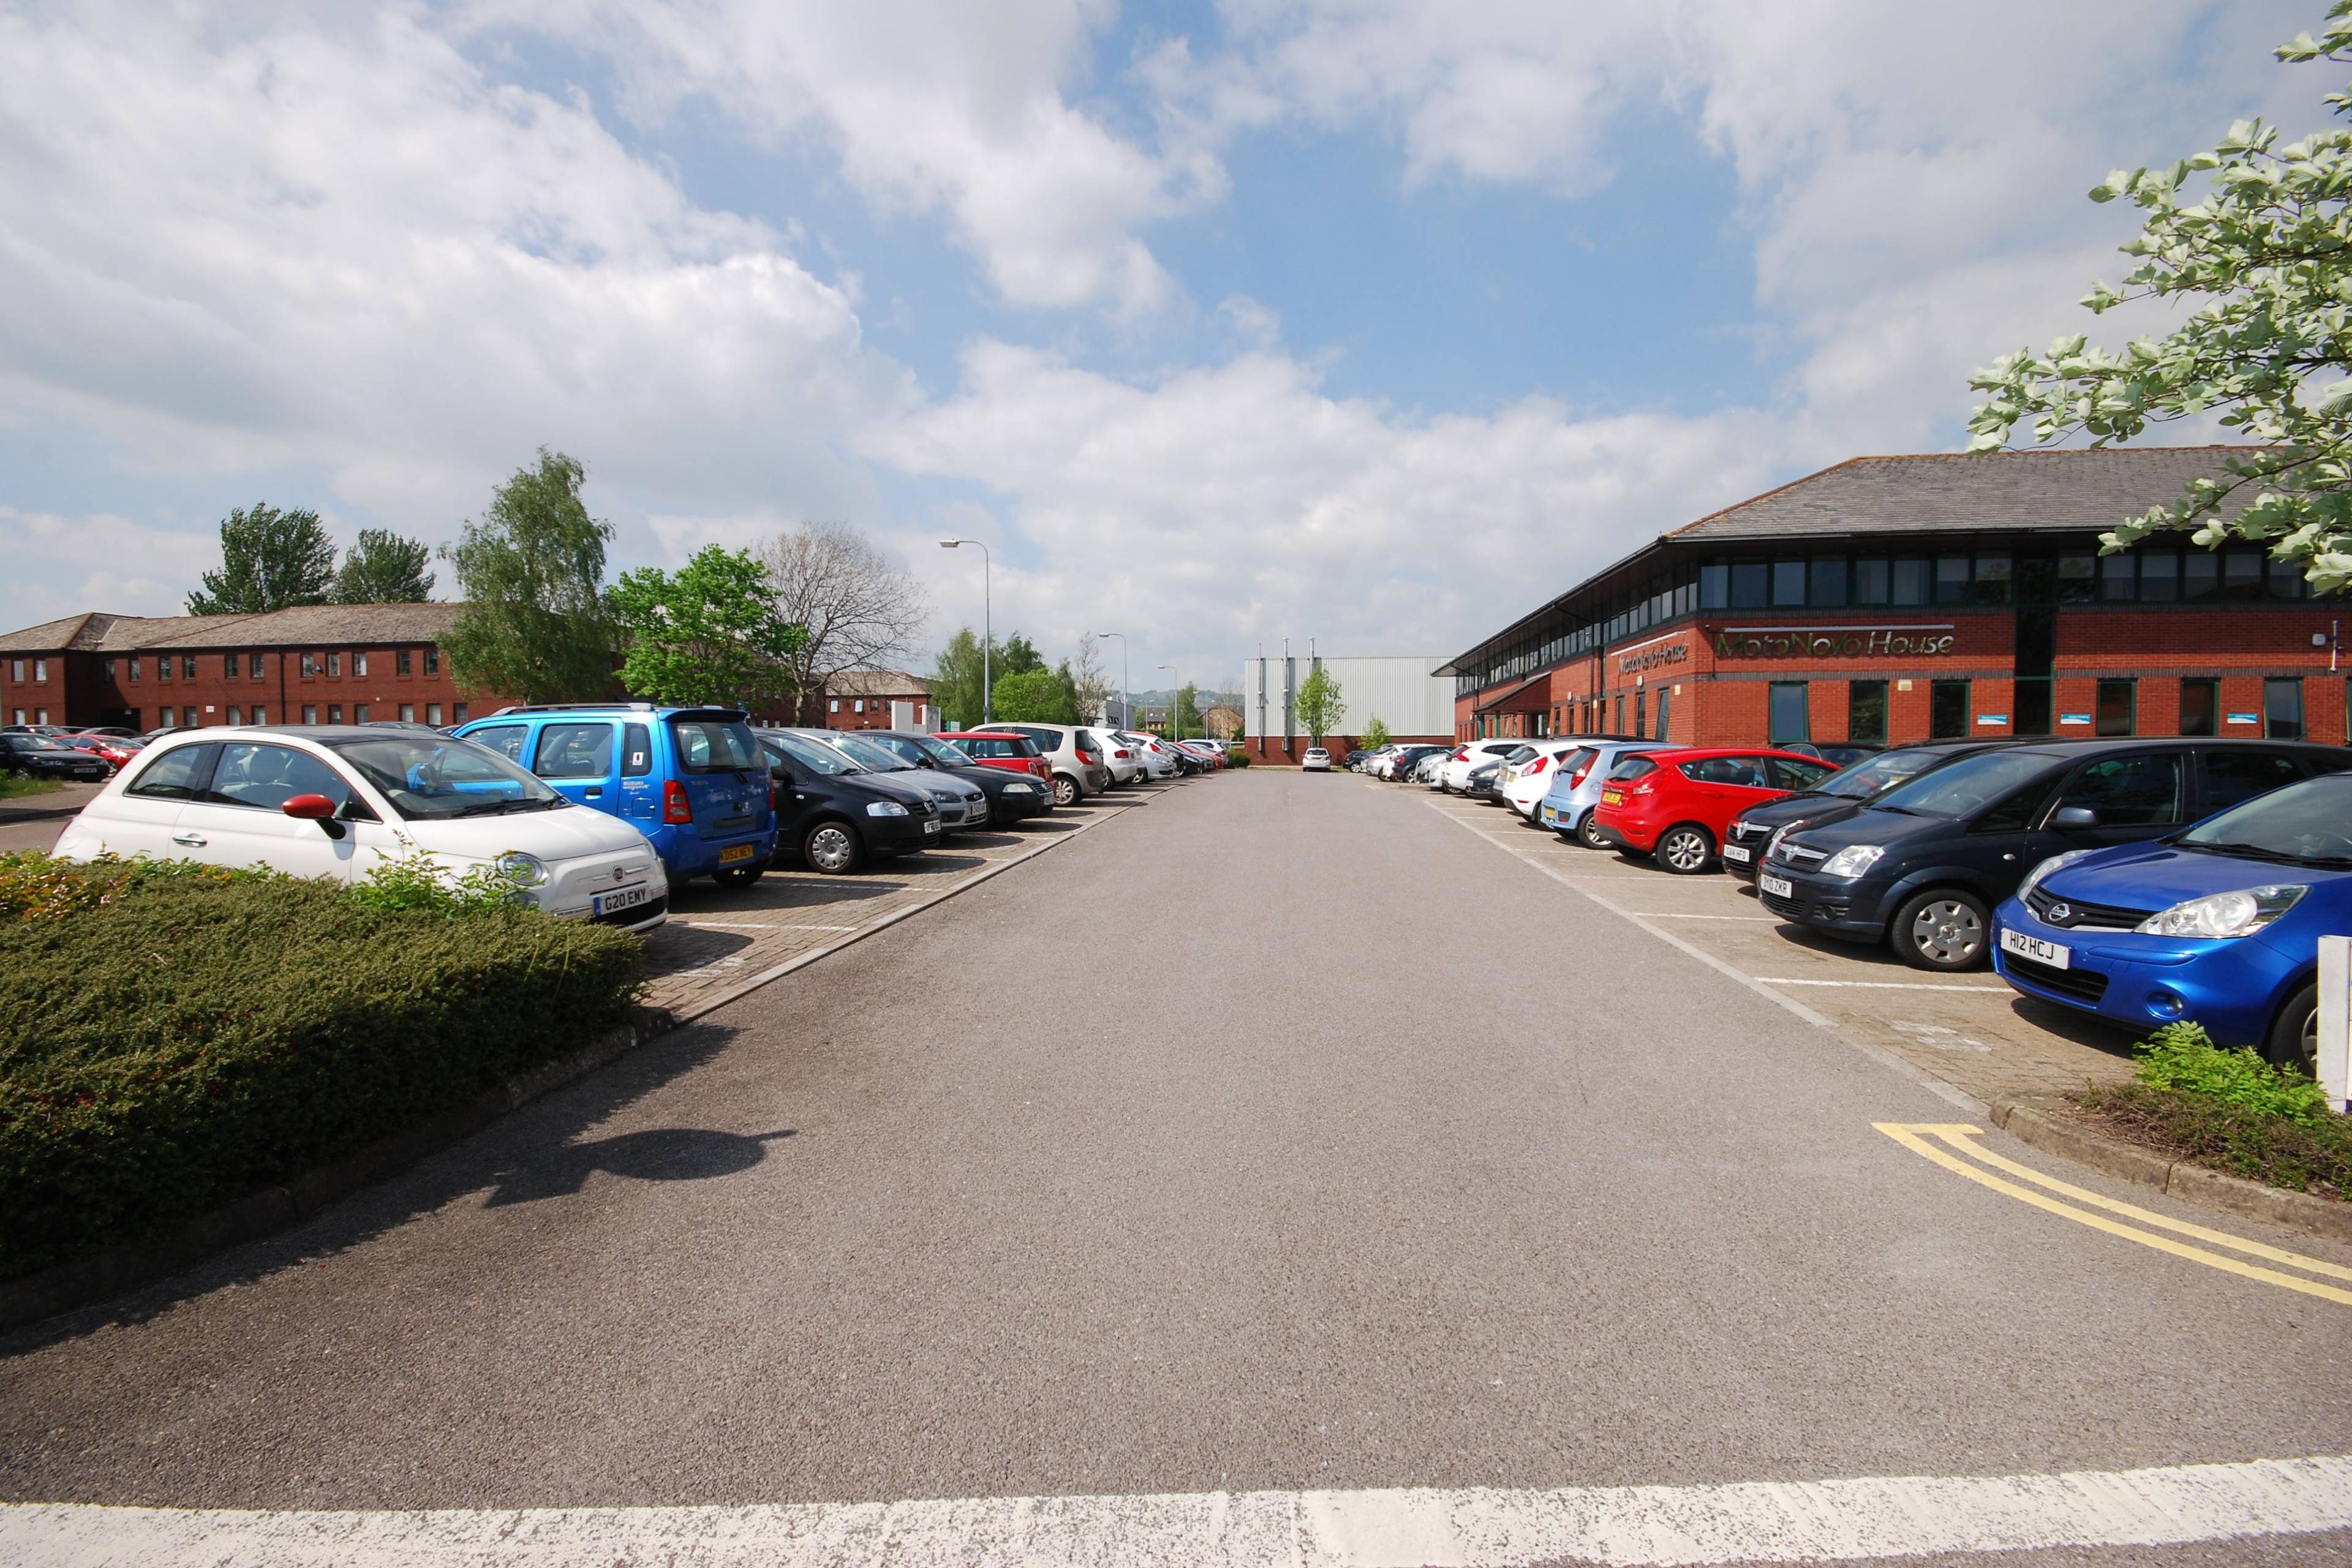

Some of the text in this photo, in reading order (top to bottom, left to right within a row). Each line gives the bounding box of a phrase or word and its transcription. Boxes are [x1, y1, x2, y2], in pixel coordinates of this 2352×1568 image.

[1659, 643, 1687, 665] House
[1717, 631, 1954, 657] MotoNovo House
[1774, 880, 1787, 894] ZKR
[605, 888, 646, 910] G20 EMY
[2010, 932, 2054, 959] H12 HCJ
